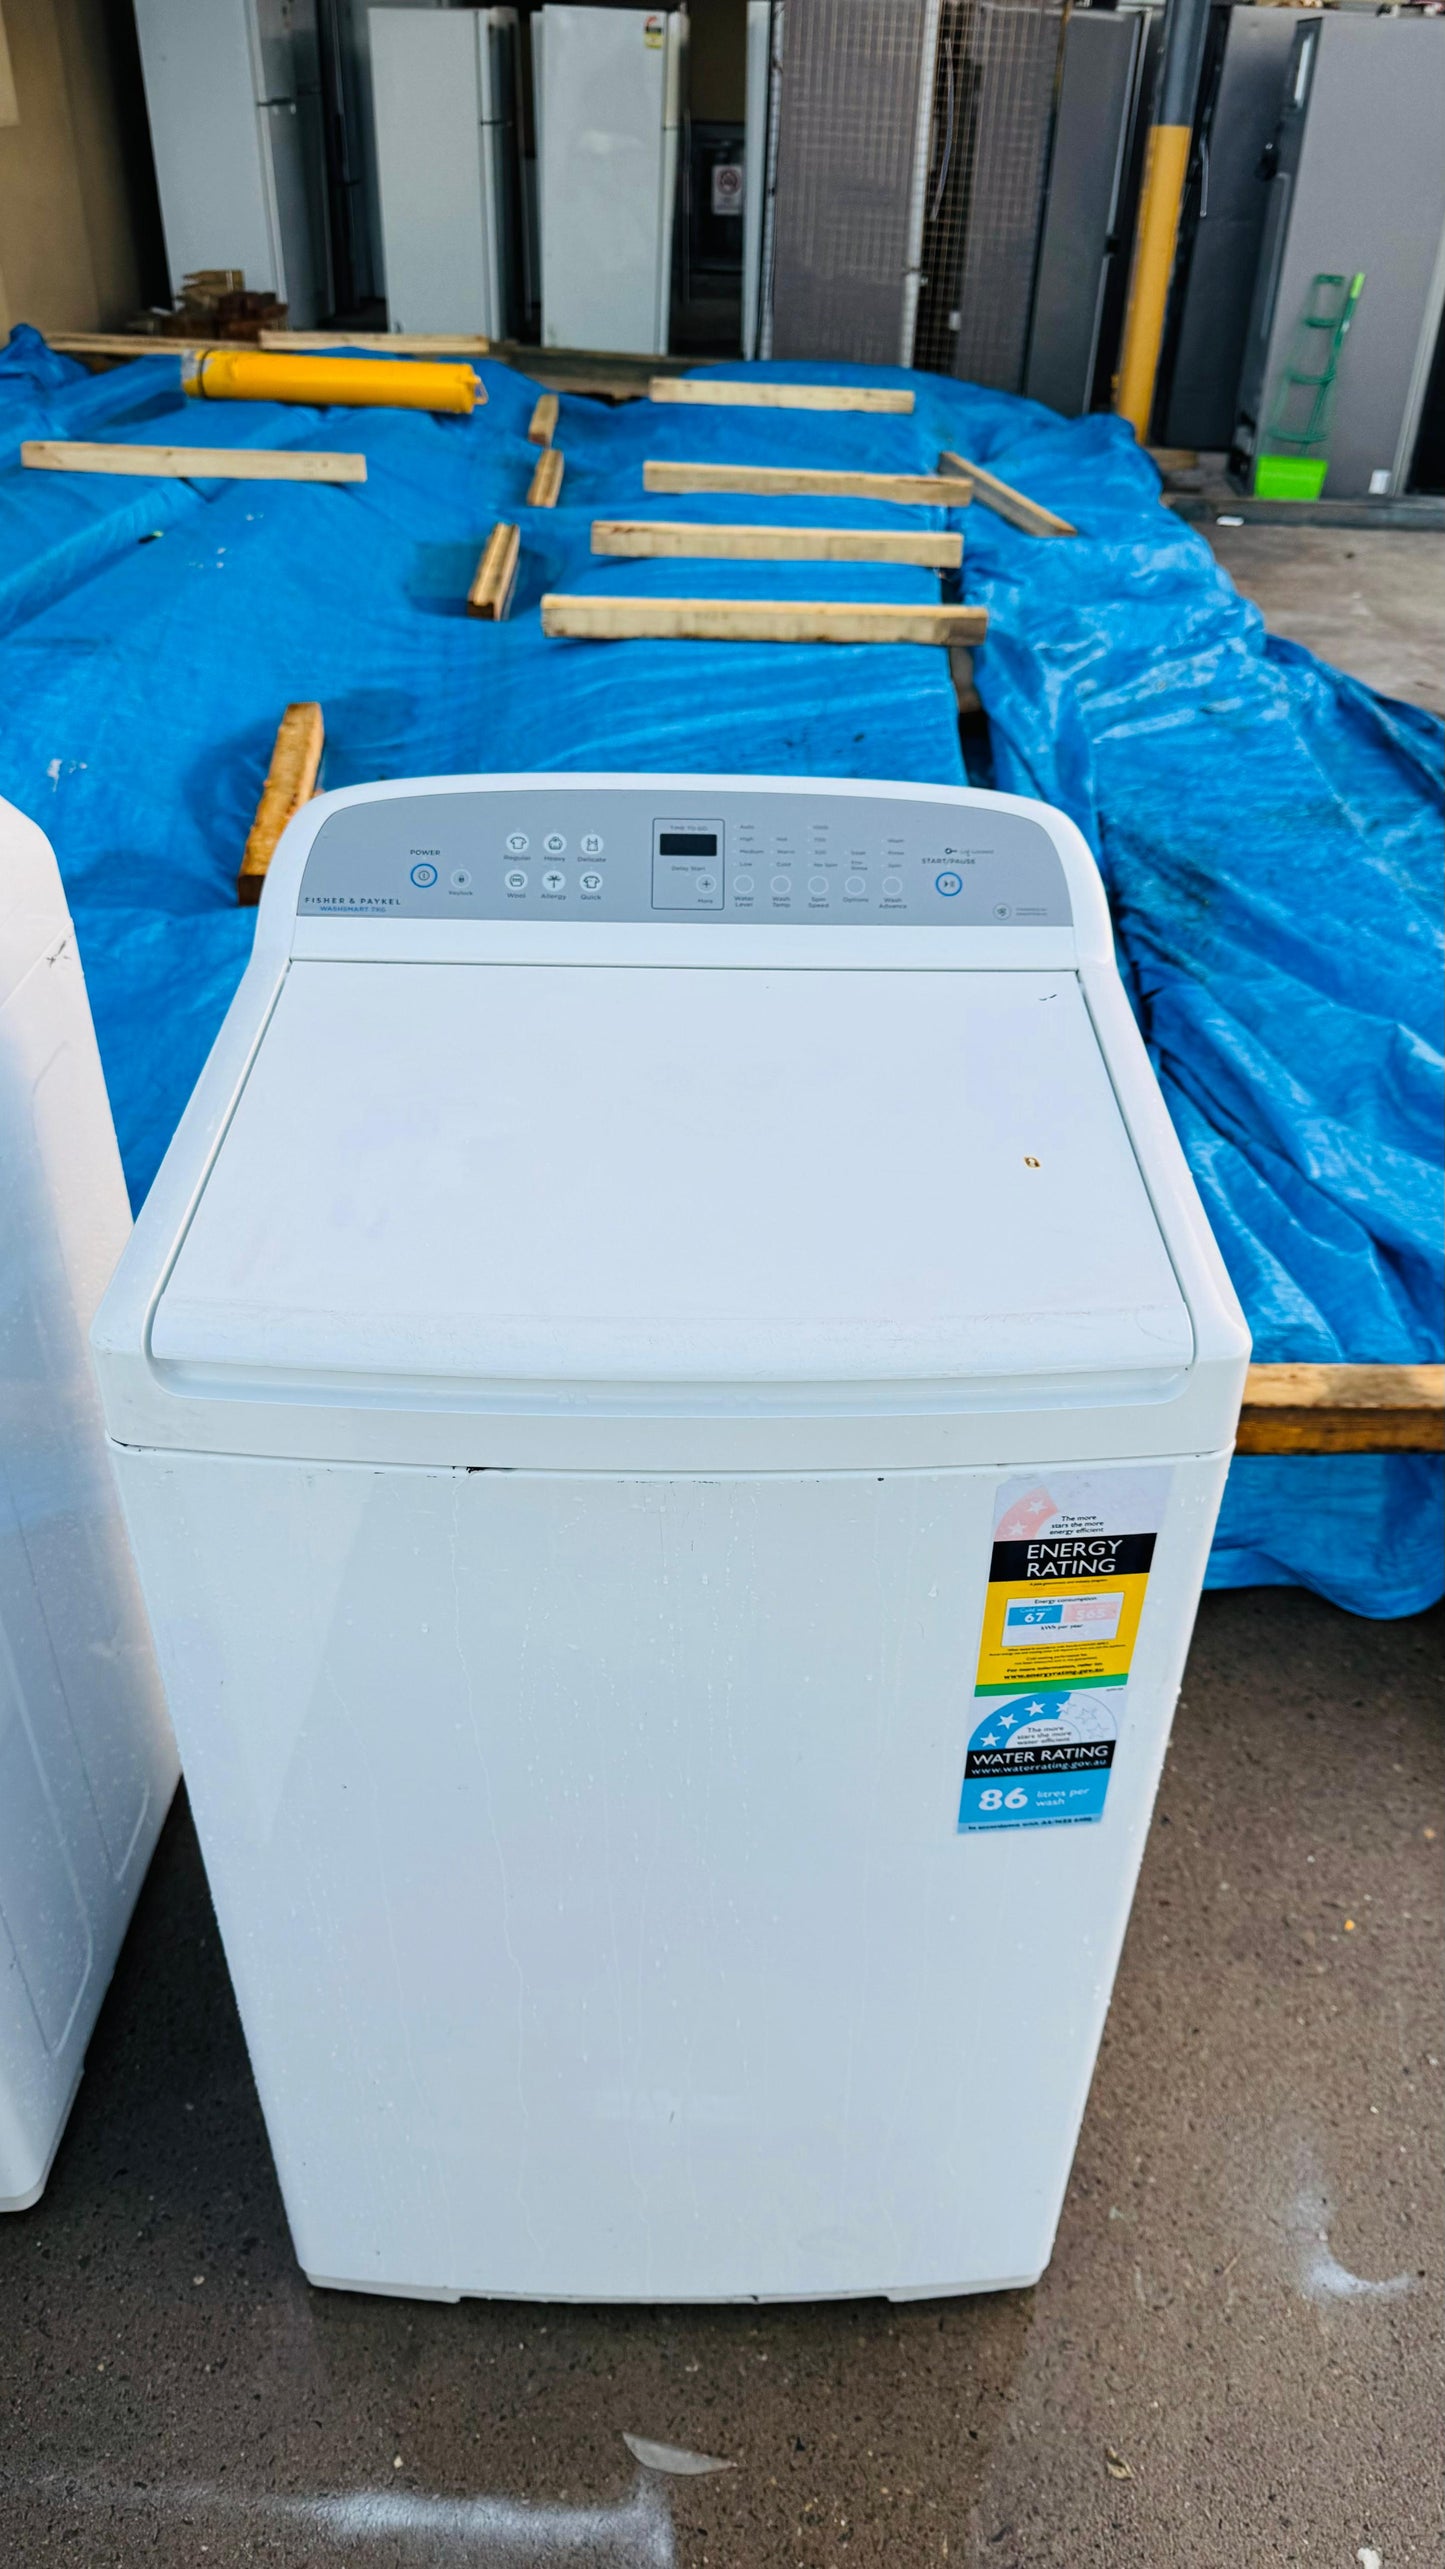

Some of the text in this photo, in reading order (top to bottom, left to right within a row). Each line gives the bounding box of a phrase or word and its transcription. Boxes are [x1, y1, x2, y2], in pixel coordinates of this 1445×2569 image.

[1027, 1540, 1123, 1559] ENERGY
[1026, 1559, 1117, 1577] RATING
[1024, 1612, 1045, 1623] 67
[1004, 1668, 1104, 1679] www.energyrating.gov.au
[973, 1745, 1109, 1765] WATER RATING
[971, 1759, 1107, 1775] www.waterrating.gov.au
[978, 1787, 1090, 1811] 86 litres per
[1036, 1798, 1065, 1807] wash
